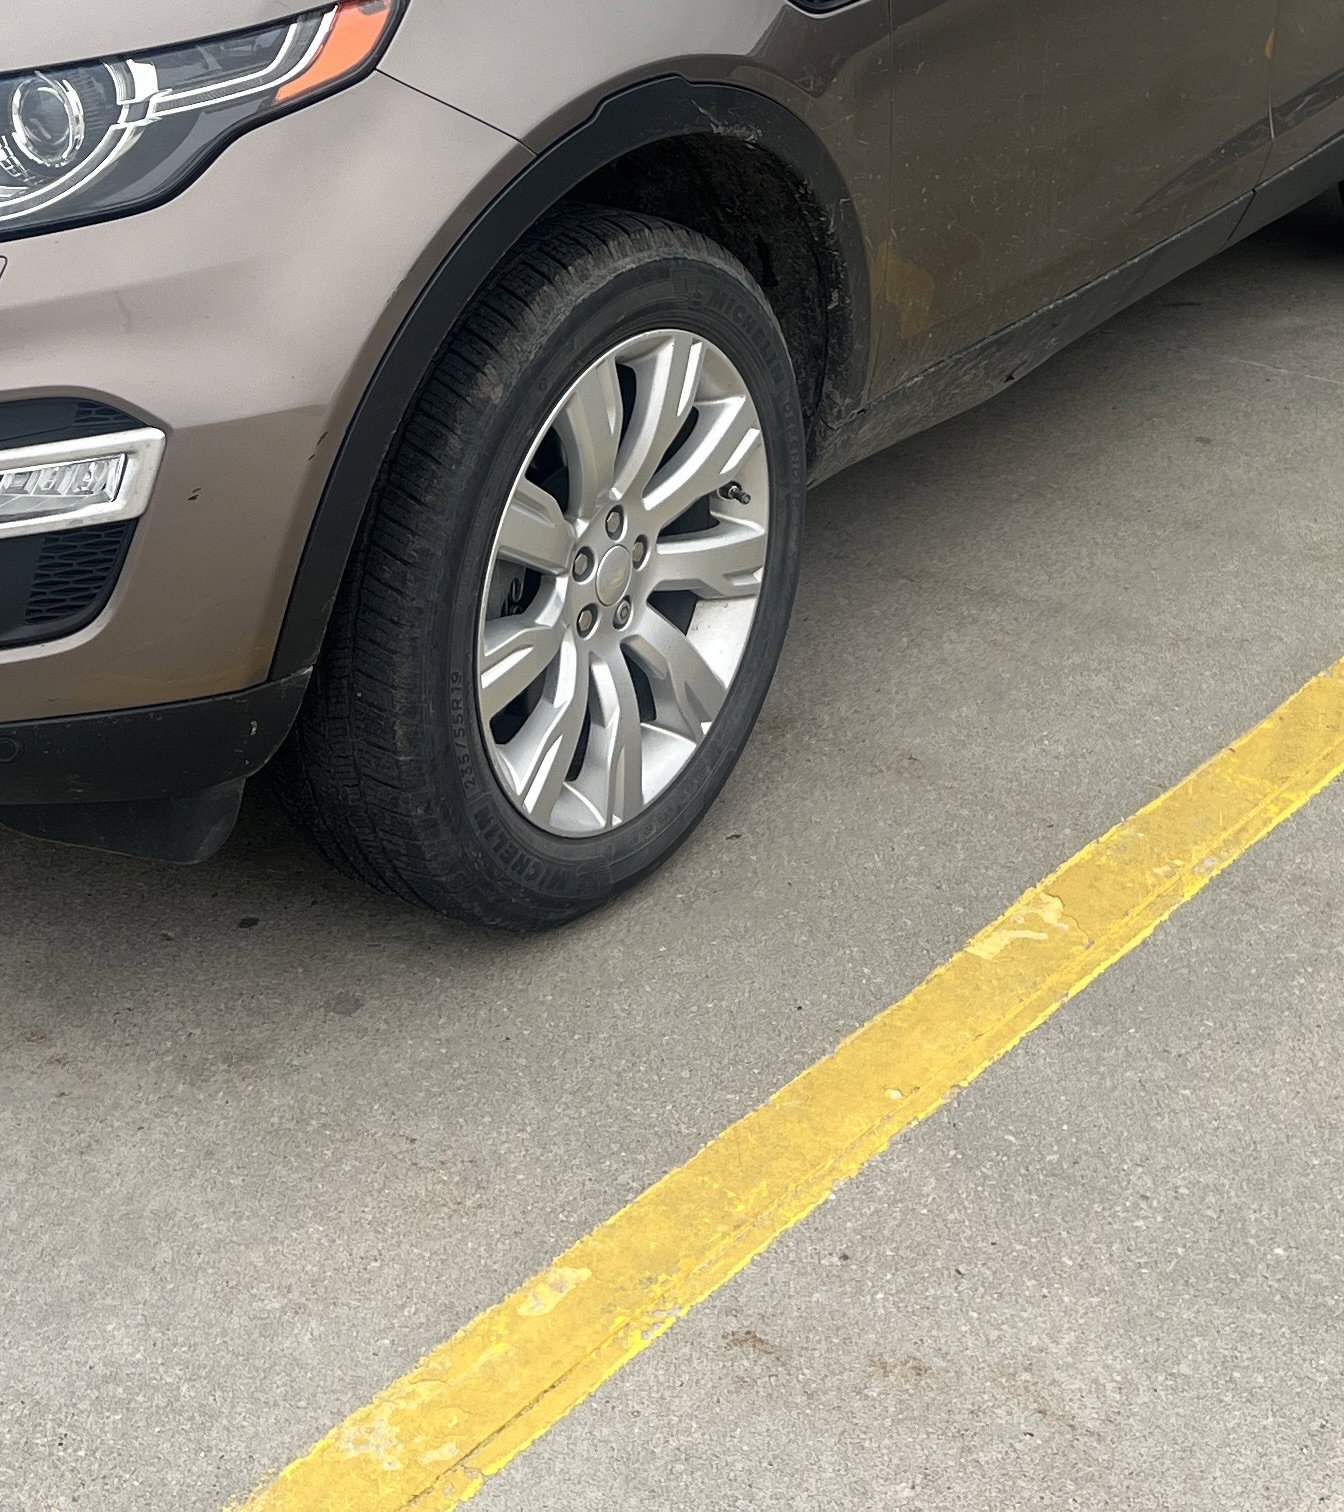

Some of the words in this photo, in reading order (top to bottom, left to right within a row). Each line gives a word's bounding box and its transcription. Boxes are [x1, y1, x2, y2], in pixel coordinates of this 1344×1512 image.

[706, 286, 786, 386] MICHELIN
[449, 670, 477, 791] 235/55R19
[472, 803, 570, 892] MICHELIN
